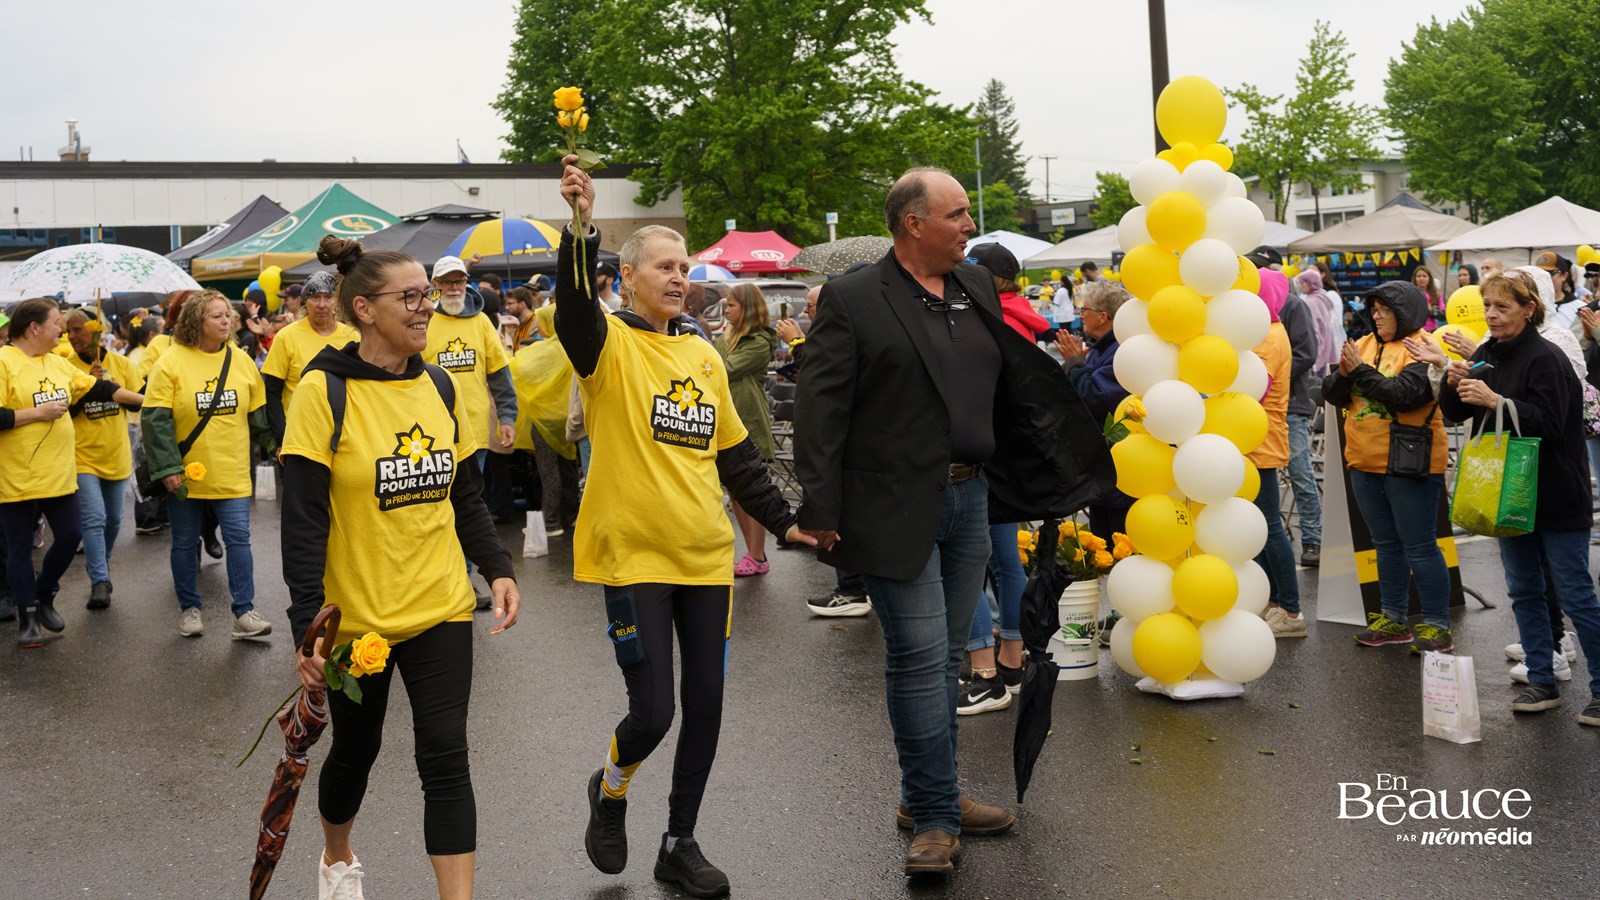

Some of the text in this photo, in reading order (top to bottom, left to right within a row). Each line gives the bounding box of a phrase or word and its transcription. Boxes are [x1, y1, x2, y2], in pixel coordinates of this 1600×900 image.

[753, 251, 781, 261] KIA
[439, 350, 475, 362] RELAIS
[34, 389, 67, 403] RELAIS
[197, 391, 236, 402] REAIS
[656, 398, 714, 424] RELAIS
[653, 415, 713, 435] POUR LA VIE
[379, 452, 453, 481] RELAIS
[379, 472, 452, 493] POUR LA VIE
[392, 492, 411, 504] PREND
[616, 625, 637, 636] RELAIS
